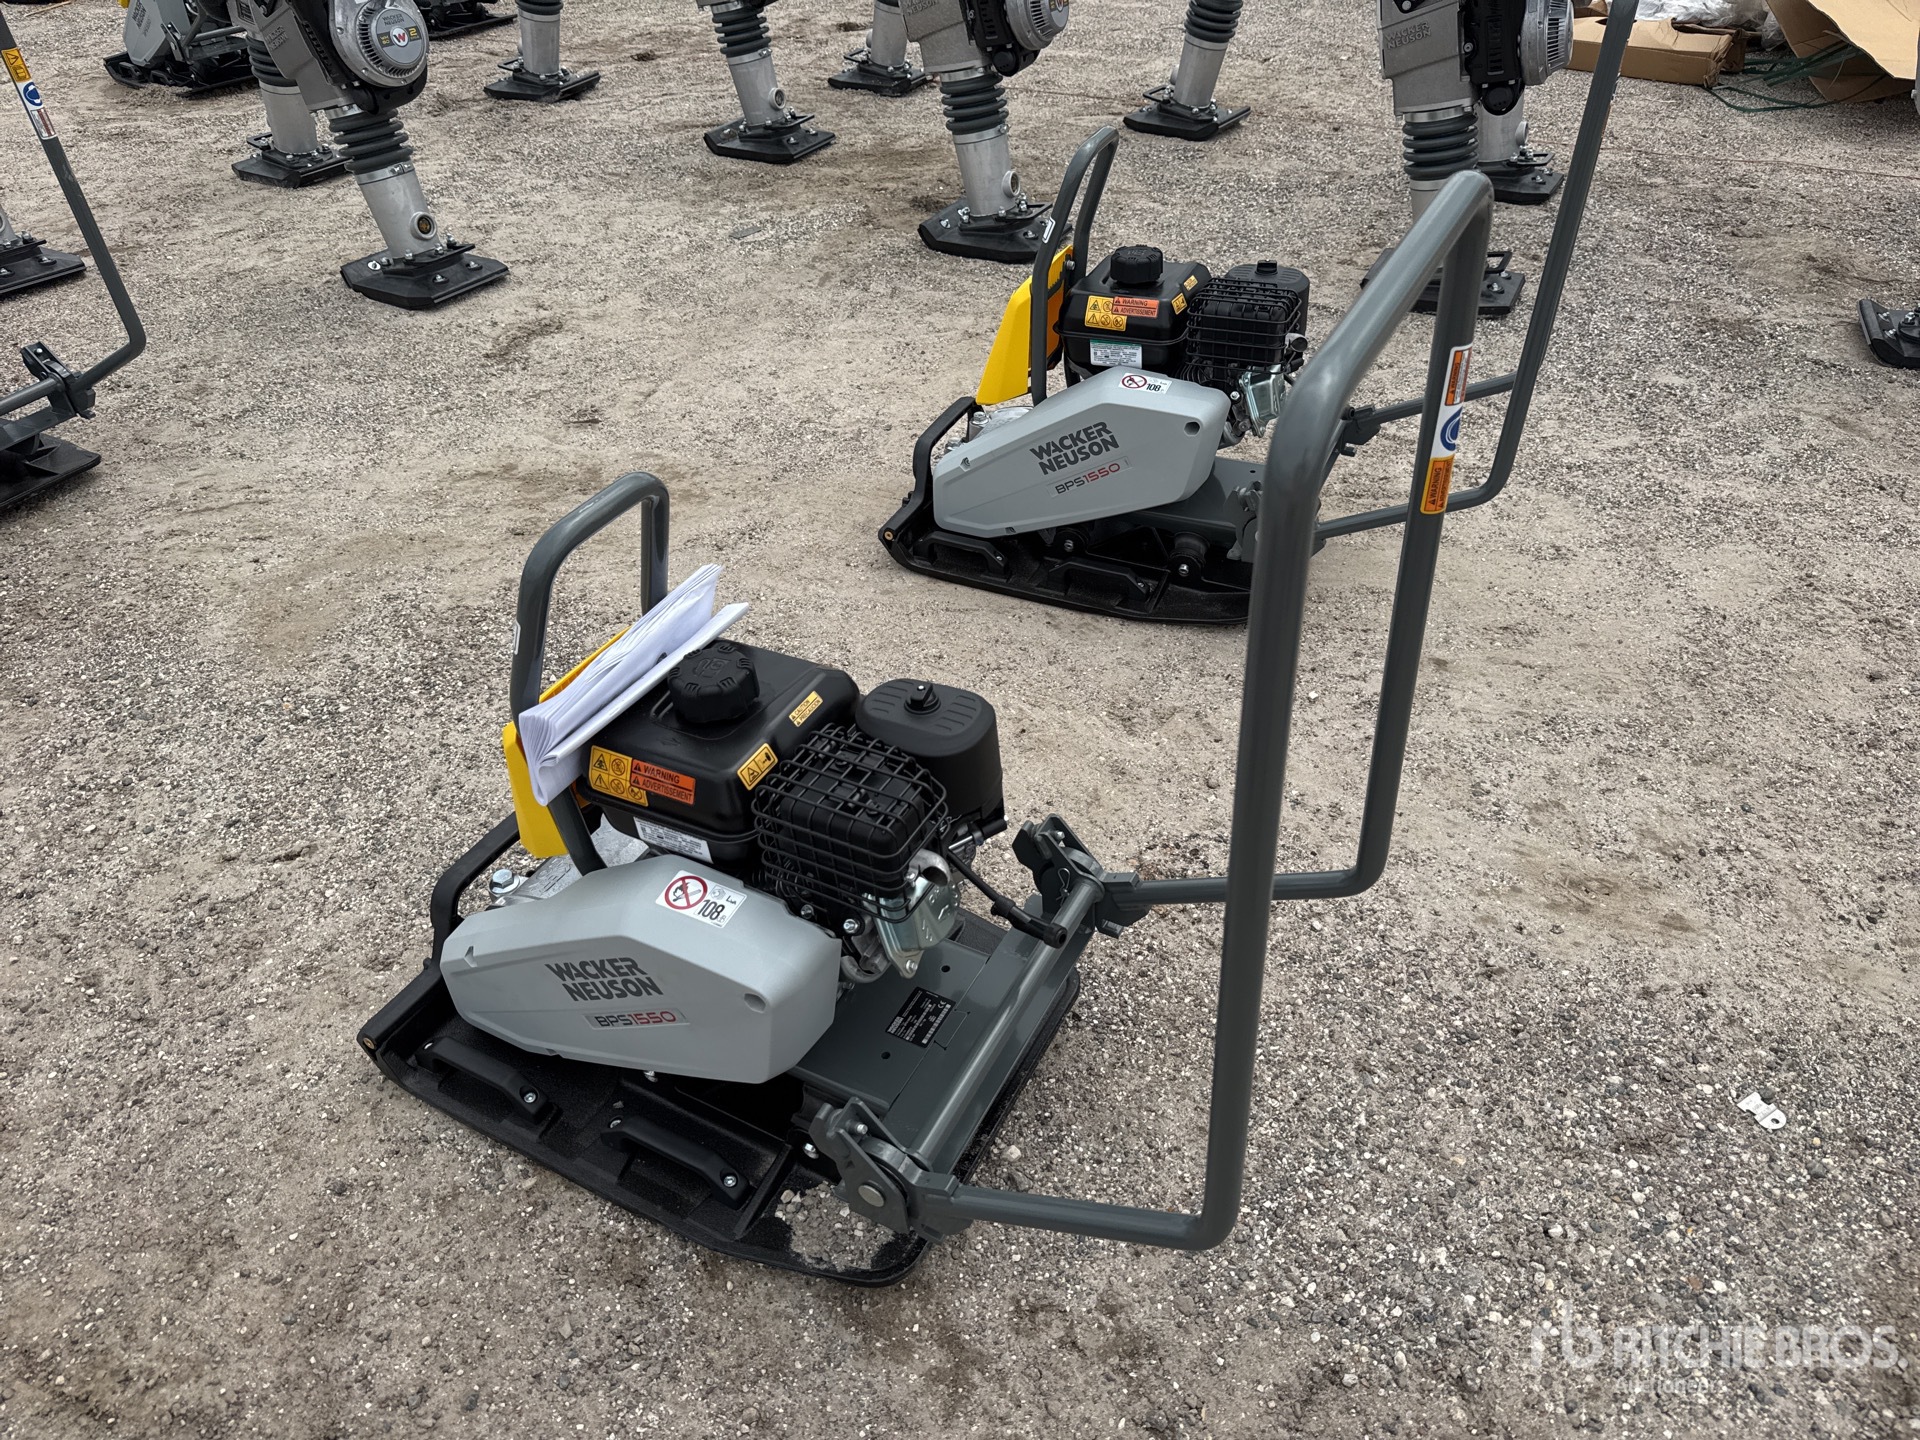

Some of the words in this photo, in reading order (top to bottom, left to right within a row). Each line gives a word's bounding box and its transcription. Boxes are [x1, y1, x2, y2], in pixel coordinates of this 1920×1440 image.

[1385, 22, 1429, 41] WACKER
[1387, 29, 1432, 49] NEUSON
[1120, 308, 1156, 317] ADVERTISSEMENT
[1146, 383, 1162, 392] 108
[1029, 421, 1113, 461] WACKER
[1038, 434, 1120, 475] NEUSON
[1055, 463, 1121, 494] BPS1550
[1429, 467, 1442, 499] WARNING
[643, 765, 680, 784] WARNING
[641, 779, 692, 801] ADVERTISSEMENT
[697, 899, 725, 921] 108
[544, 957, 648, 982] WACKER
[562, 976, 664, 1001] NEUSON
[594, 1011, 677, 1027] BPS1550
